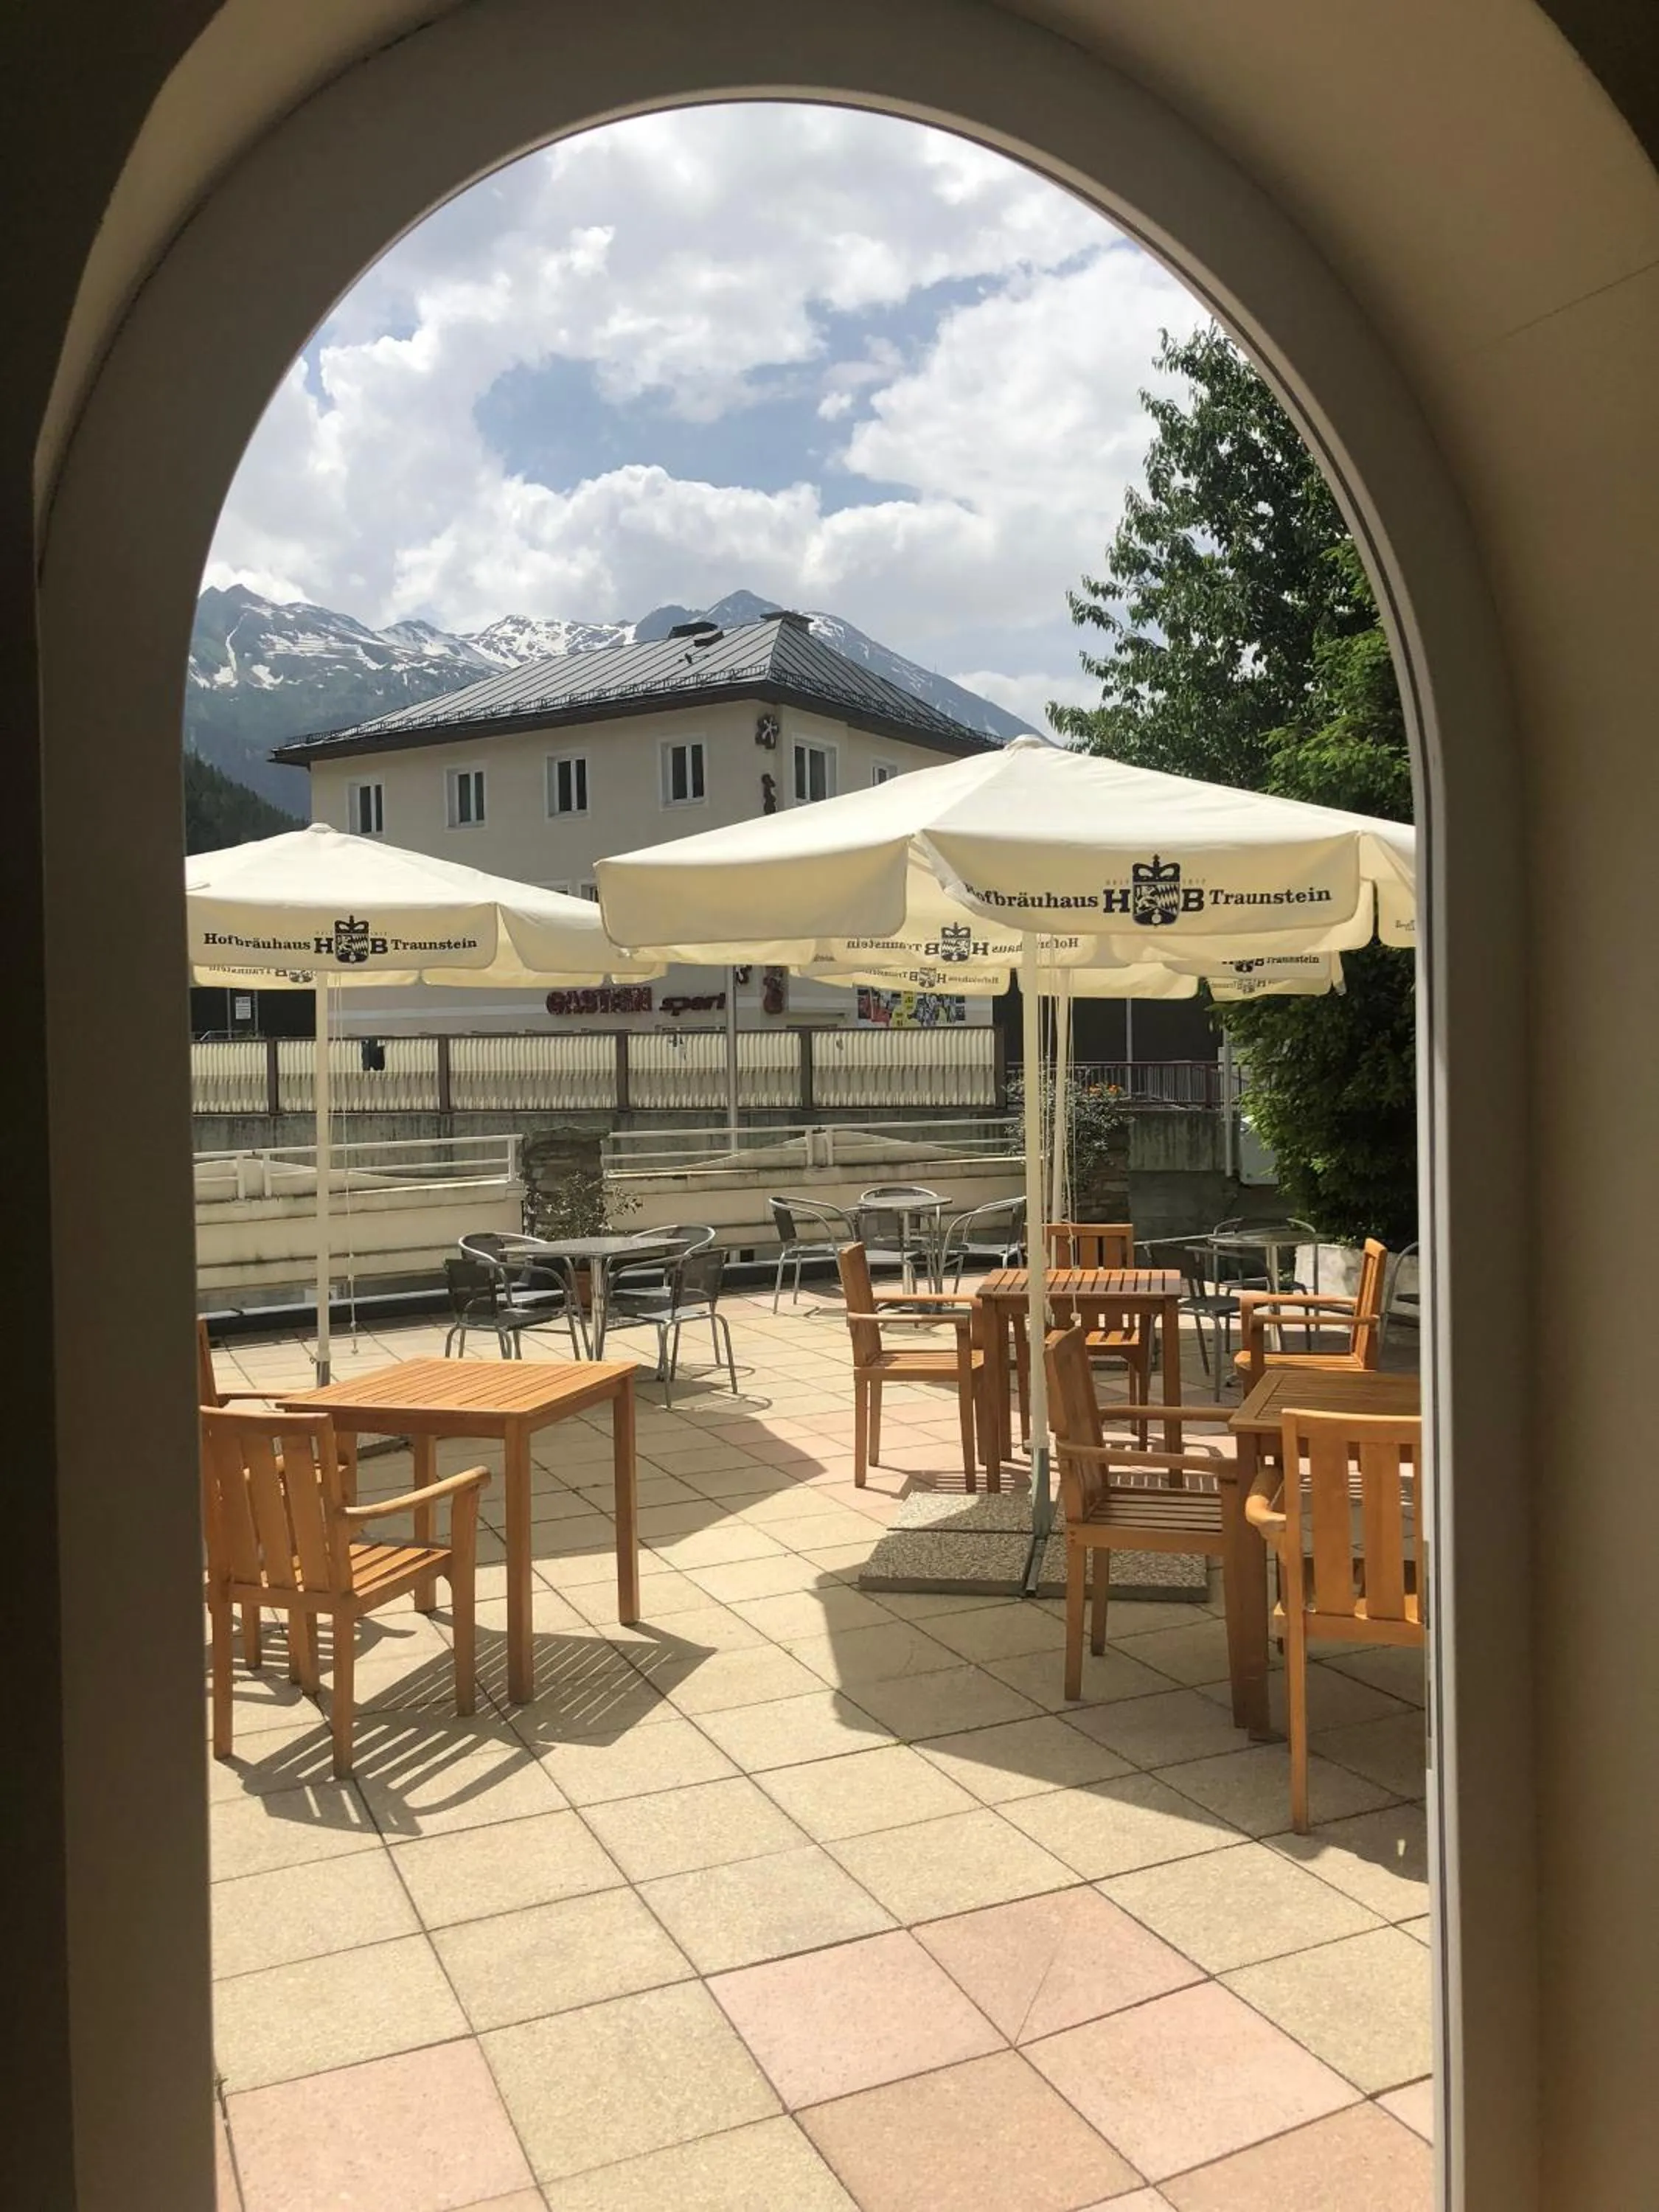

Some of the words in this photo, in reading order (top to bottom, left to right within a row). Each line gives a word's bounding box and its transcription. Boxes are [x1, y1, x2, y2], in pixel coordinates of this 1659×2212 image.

[1102, 888, 1130, 913] H
[1180, 888, 1205, 912] B
[1209, 888, 1332, 905] Traunstein
[204, 933, 310, 951] Hofbräuhaus
[314, 937, 333, 954] H
[370, 938, 388, 954] B
[391, 938, 478, 950] Traunstein
